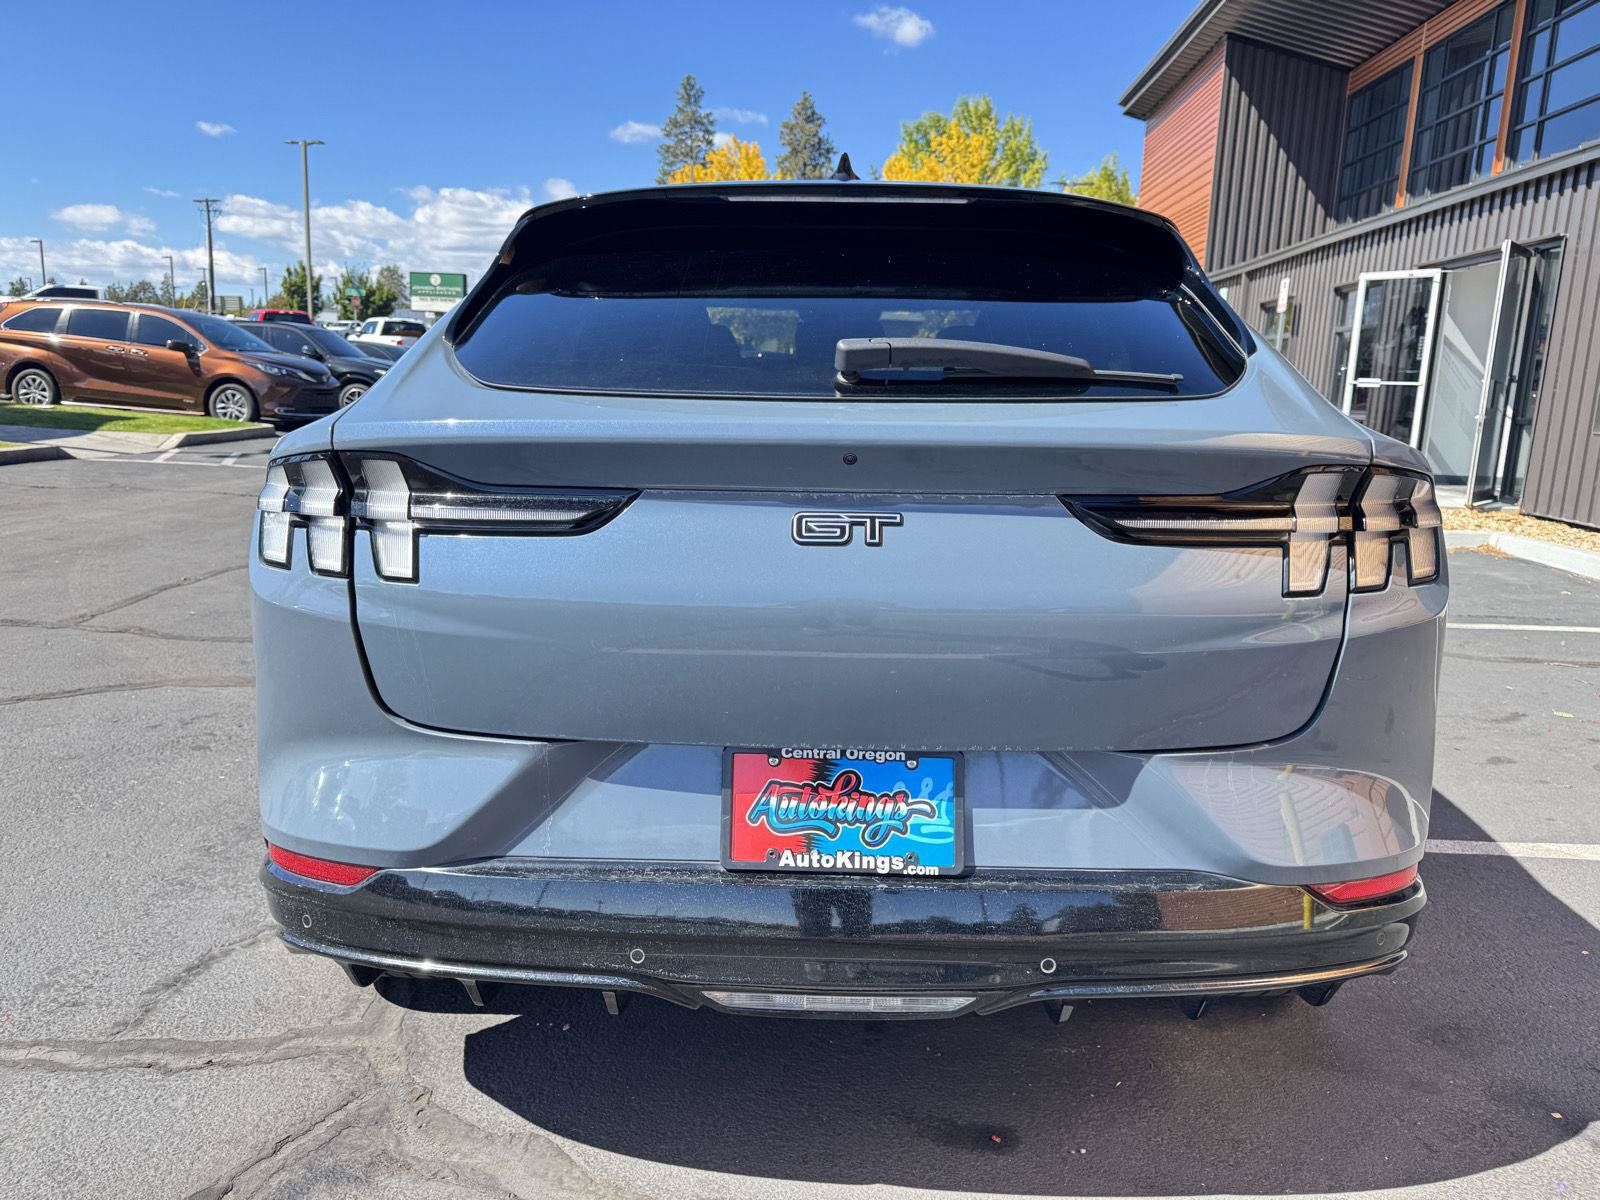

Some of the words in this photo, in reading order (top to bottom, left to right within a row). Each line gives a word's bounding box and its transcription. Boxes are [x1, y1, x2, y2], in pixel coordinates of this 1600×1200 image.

[792, 511, 904, 546] GT
[781, 747, 840, 760] Central
[846, 749, 906, 762] Oregon
[779, 850, 939, 875] AutoKings.com
